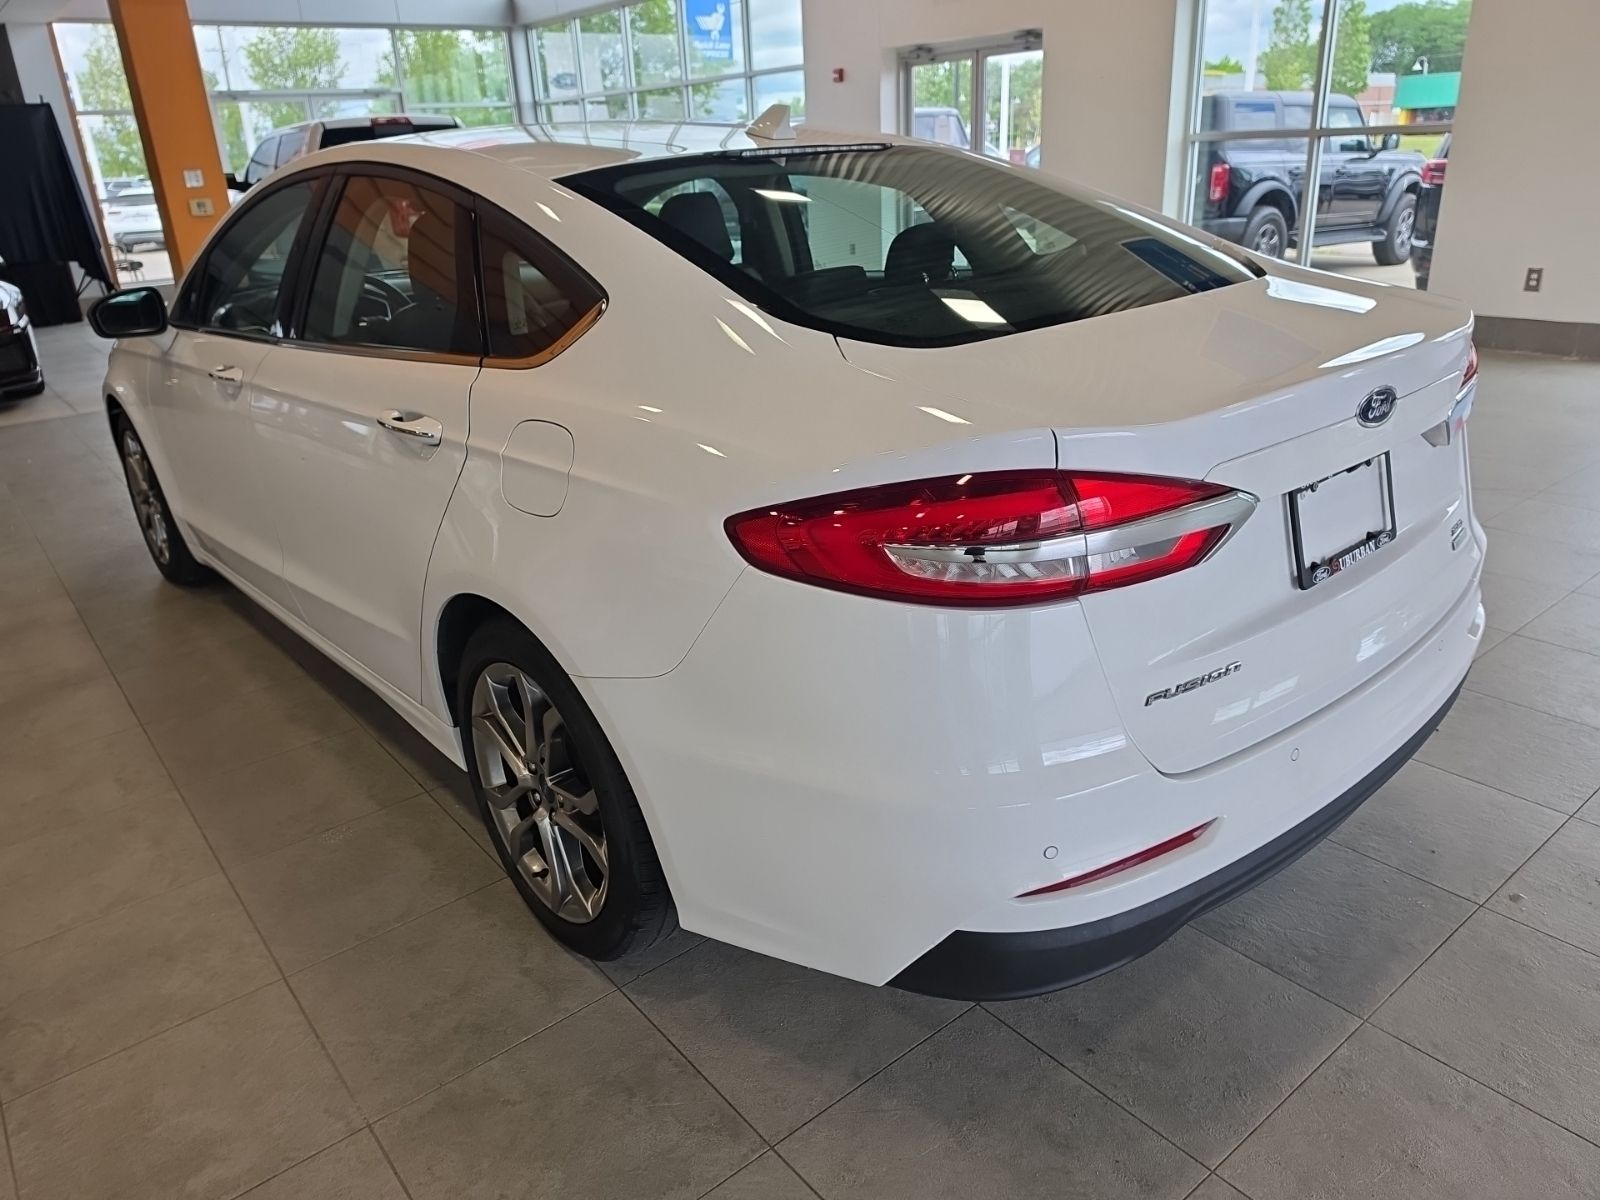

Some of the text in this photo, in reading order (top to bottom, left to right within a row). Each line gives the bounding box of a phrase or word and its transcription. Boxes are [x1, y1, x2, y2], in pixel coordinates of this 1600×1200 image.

[1368, 393, 1391, 419] Ford
[1331, 540, 1376, 572] SUBURBAN
[1144, 660, 1241, 707] FUSION
